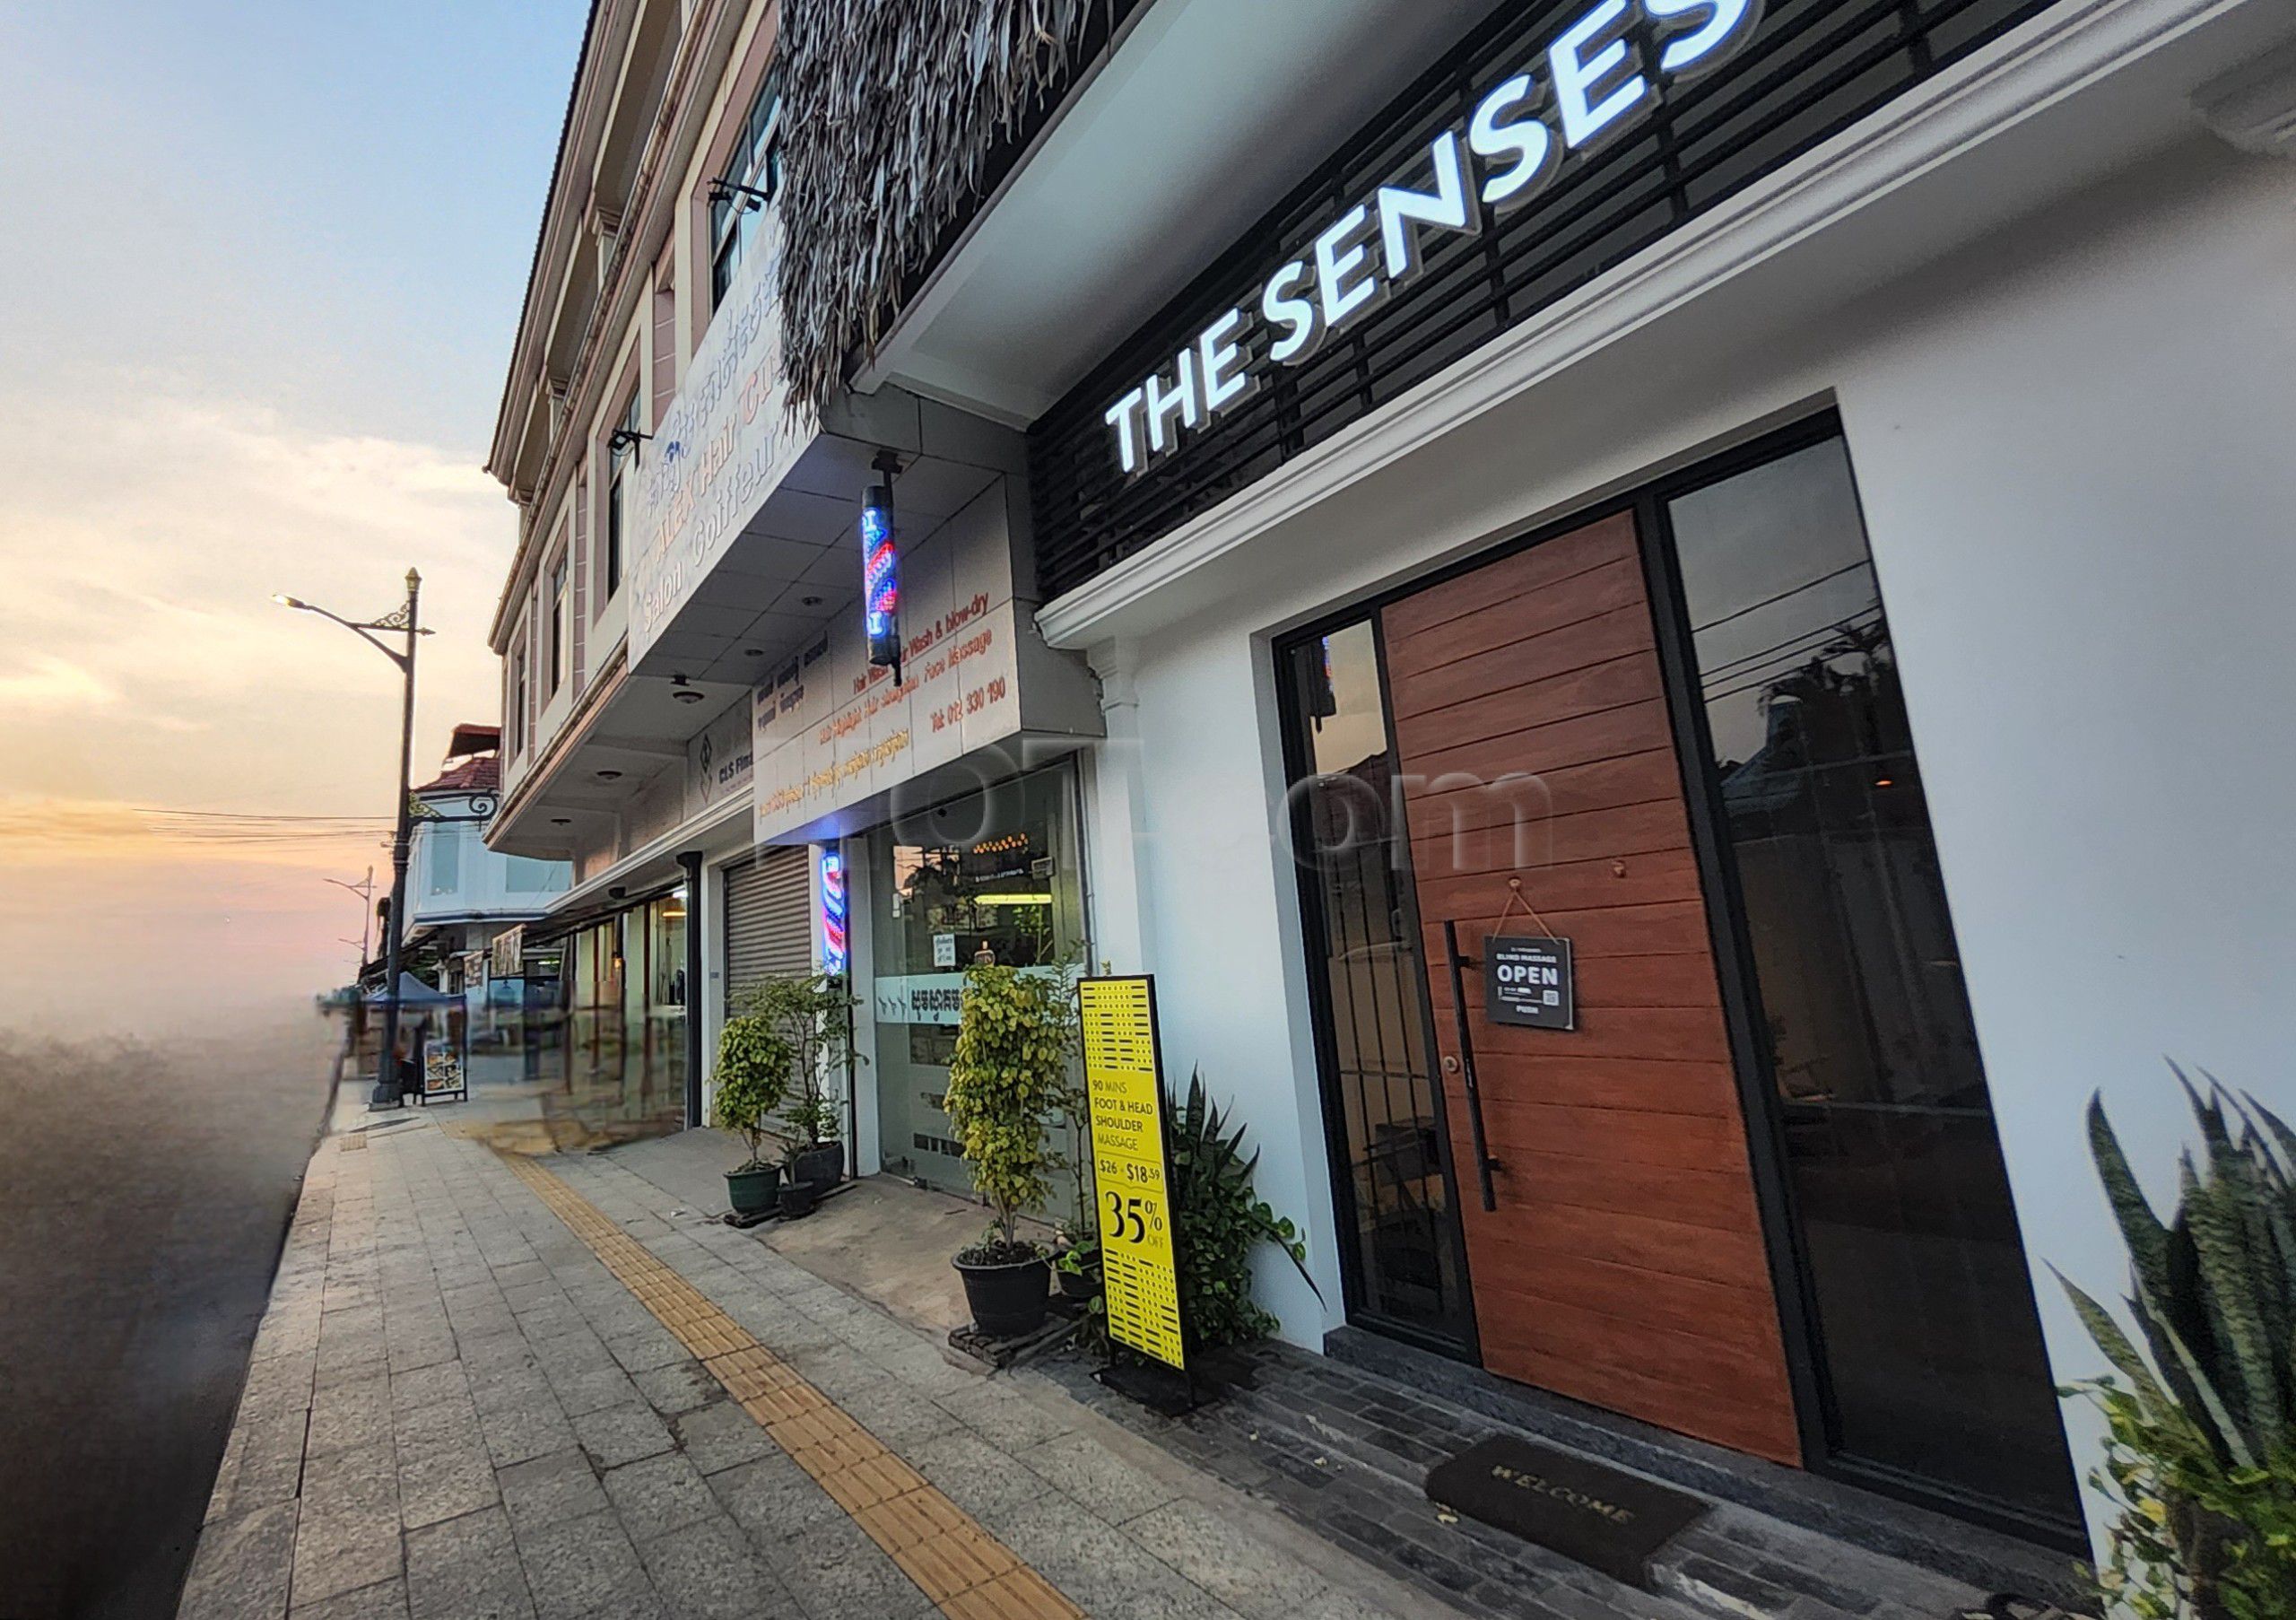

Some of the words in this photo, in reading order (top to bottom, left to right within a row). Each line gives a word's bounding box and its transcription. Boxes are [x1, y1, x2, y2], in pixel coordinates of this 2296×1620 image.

[1104, 309, 1248, 474] THE
[1261, 0, 1754, 364] SENSES
[643, 562, 683, 632] Salon
[935, 620, 943, 640] &
[945, 591, 989, 634] blow-dry
[948, 629, 993, 669] Massage
[1497, 964, 1559, 985] OPEN
[1092, 1079, 1103, 1092] 90
[1104, 1081, 1127, 1094] MINS
[1094, 1098, 1118, 1110] FOOT
[1119, 1100, 1126, 1111] &
[1127, 1102, 1153, 1115] HEAD
[1095, 1116, 1144, 1132] SHOULDER
[1098, 1132, 1138, 1151] MASSAGE
[1105, 1190, 1163, 1244] 35%
[1492, 1464, 1637, 1525] WELCOME
